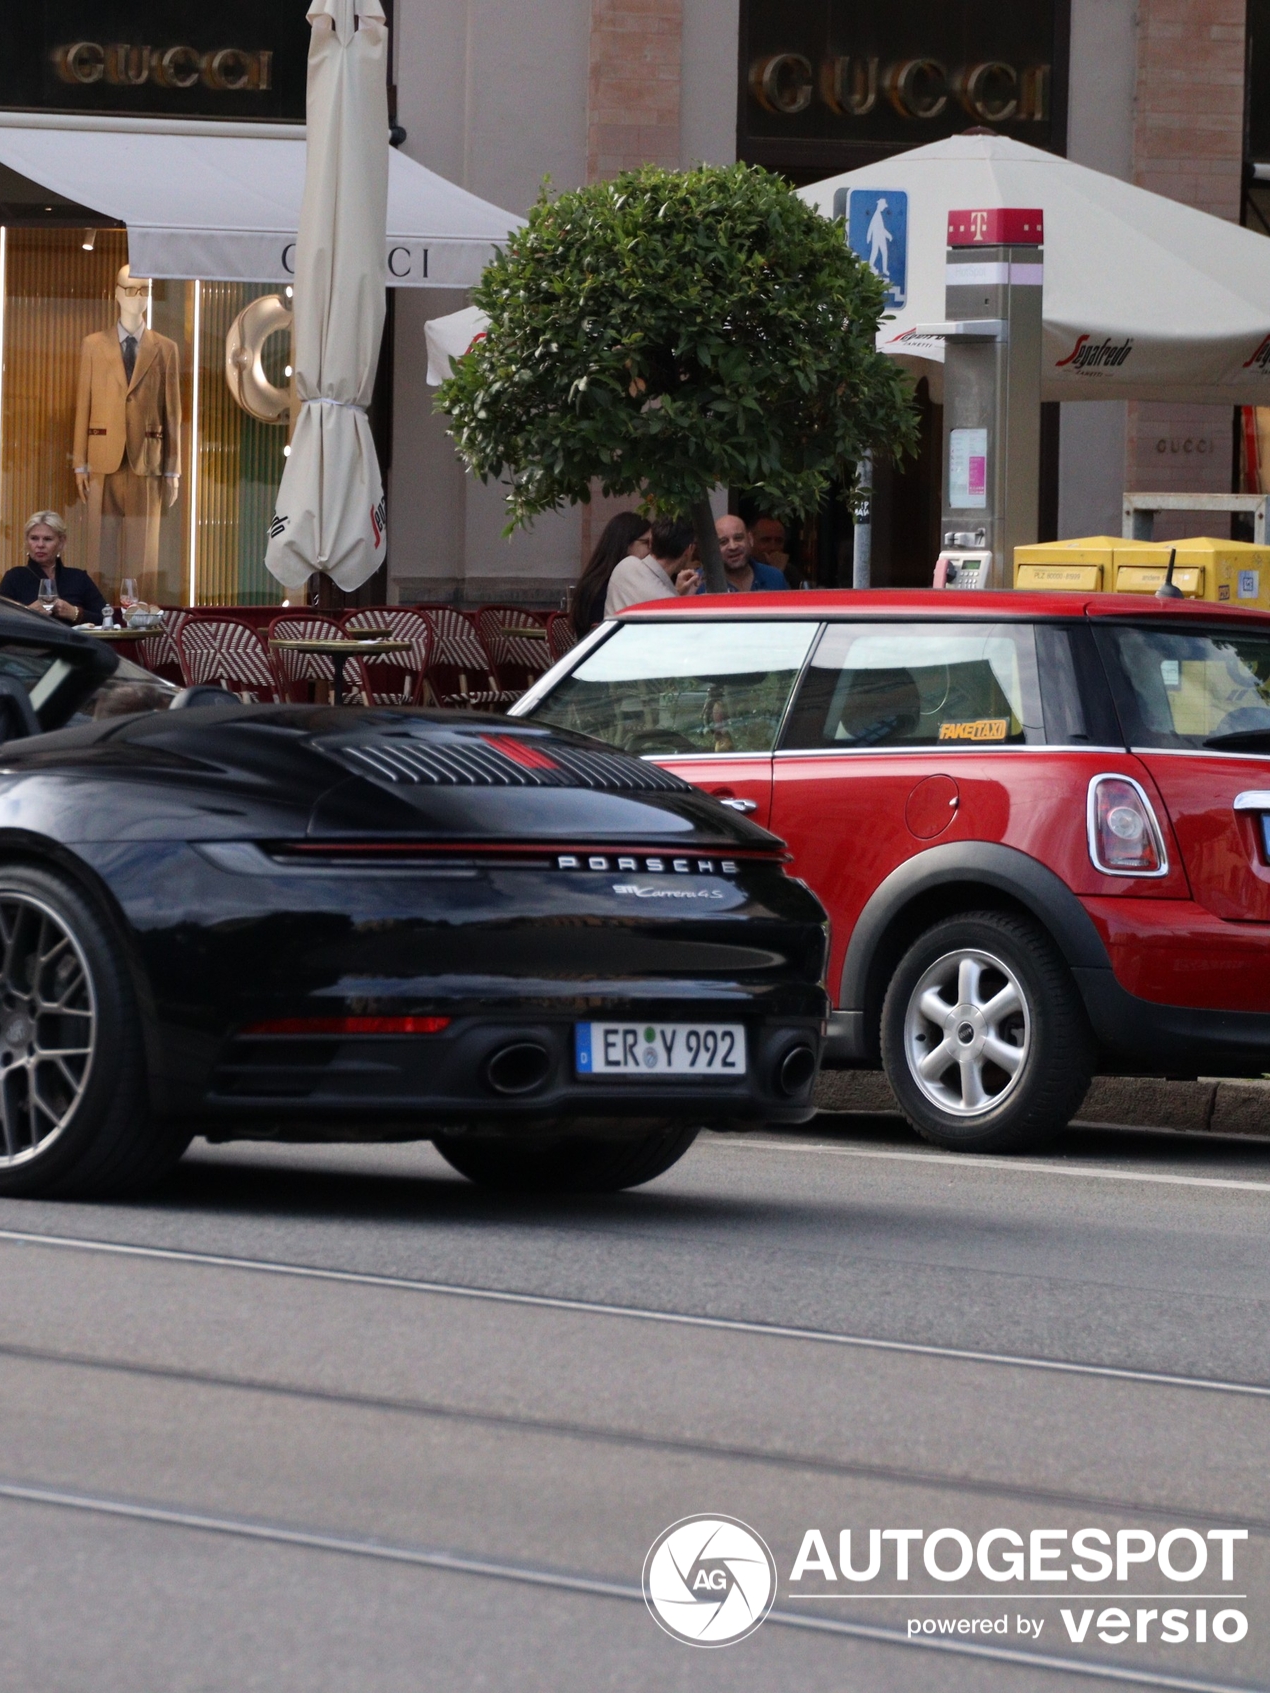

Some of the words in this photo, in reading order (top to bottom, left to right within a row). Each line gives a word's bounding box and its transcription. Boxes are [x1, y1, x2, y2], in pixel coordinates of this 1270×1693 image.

[58, 42, 273, 90] GUCCI
[752, 54, 1050, 121] GUCCI
[970, 211, 988, 241] T
[1055, 334, 1133, 369] Segafredo
[558, 855, 738, 874] PORSCHE
[635, 887, 697, 898] Carrera
[603, 1028, 640, 1067] ER
[660, 1029, 676, 1067] Y
[686, 1029, 736, 1068] 992
